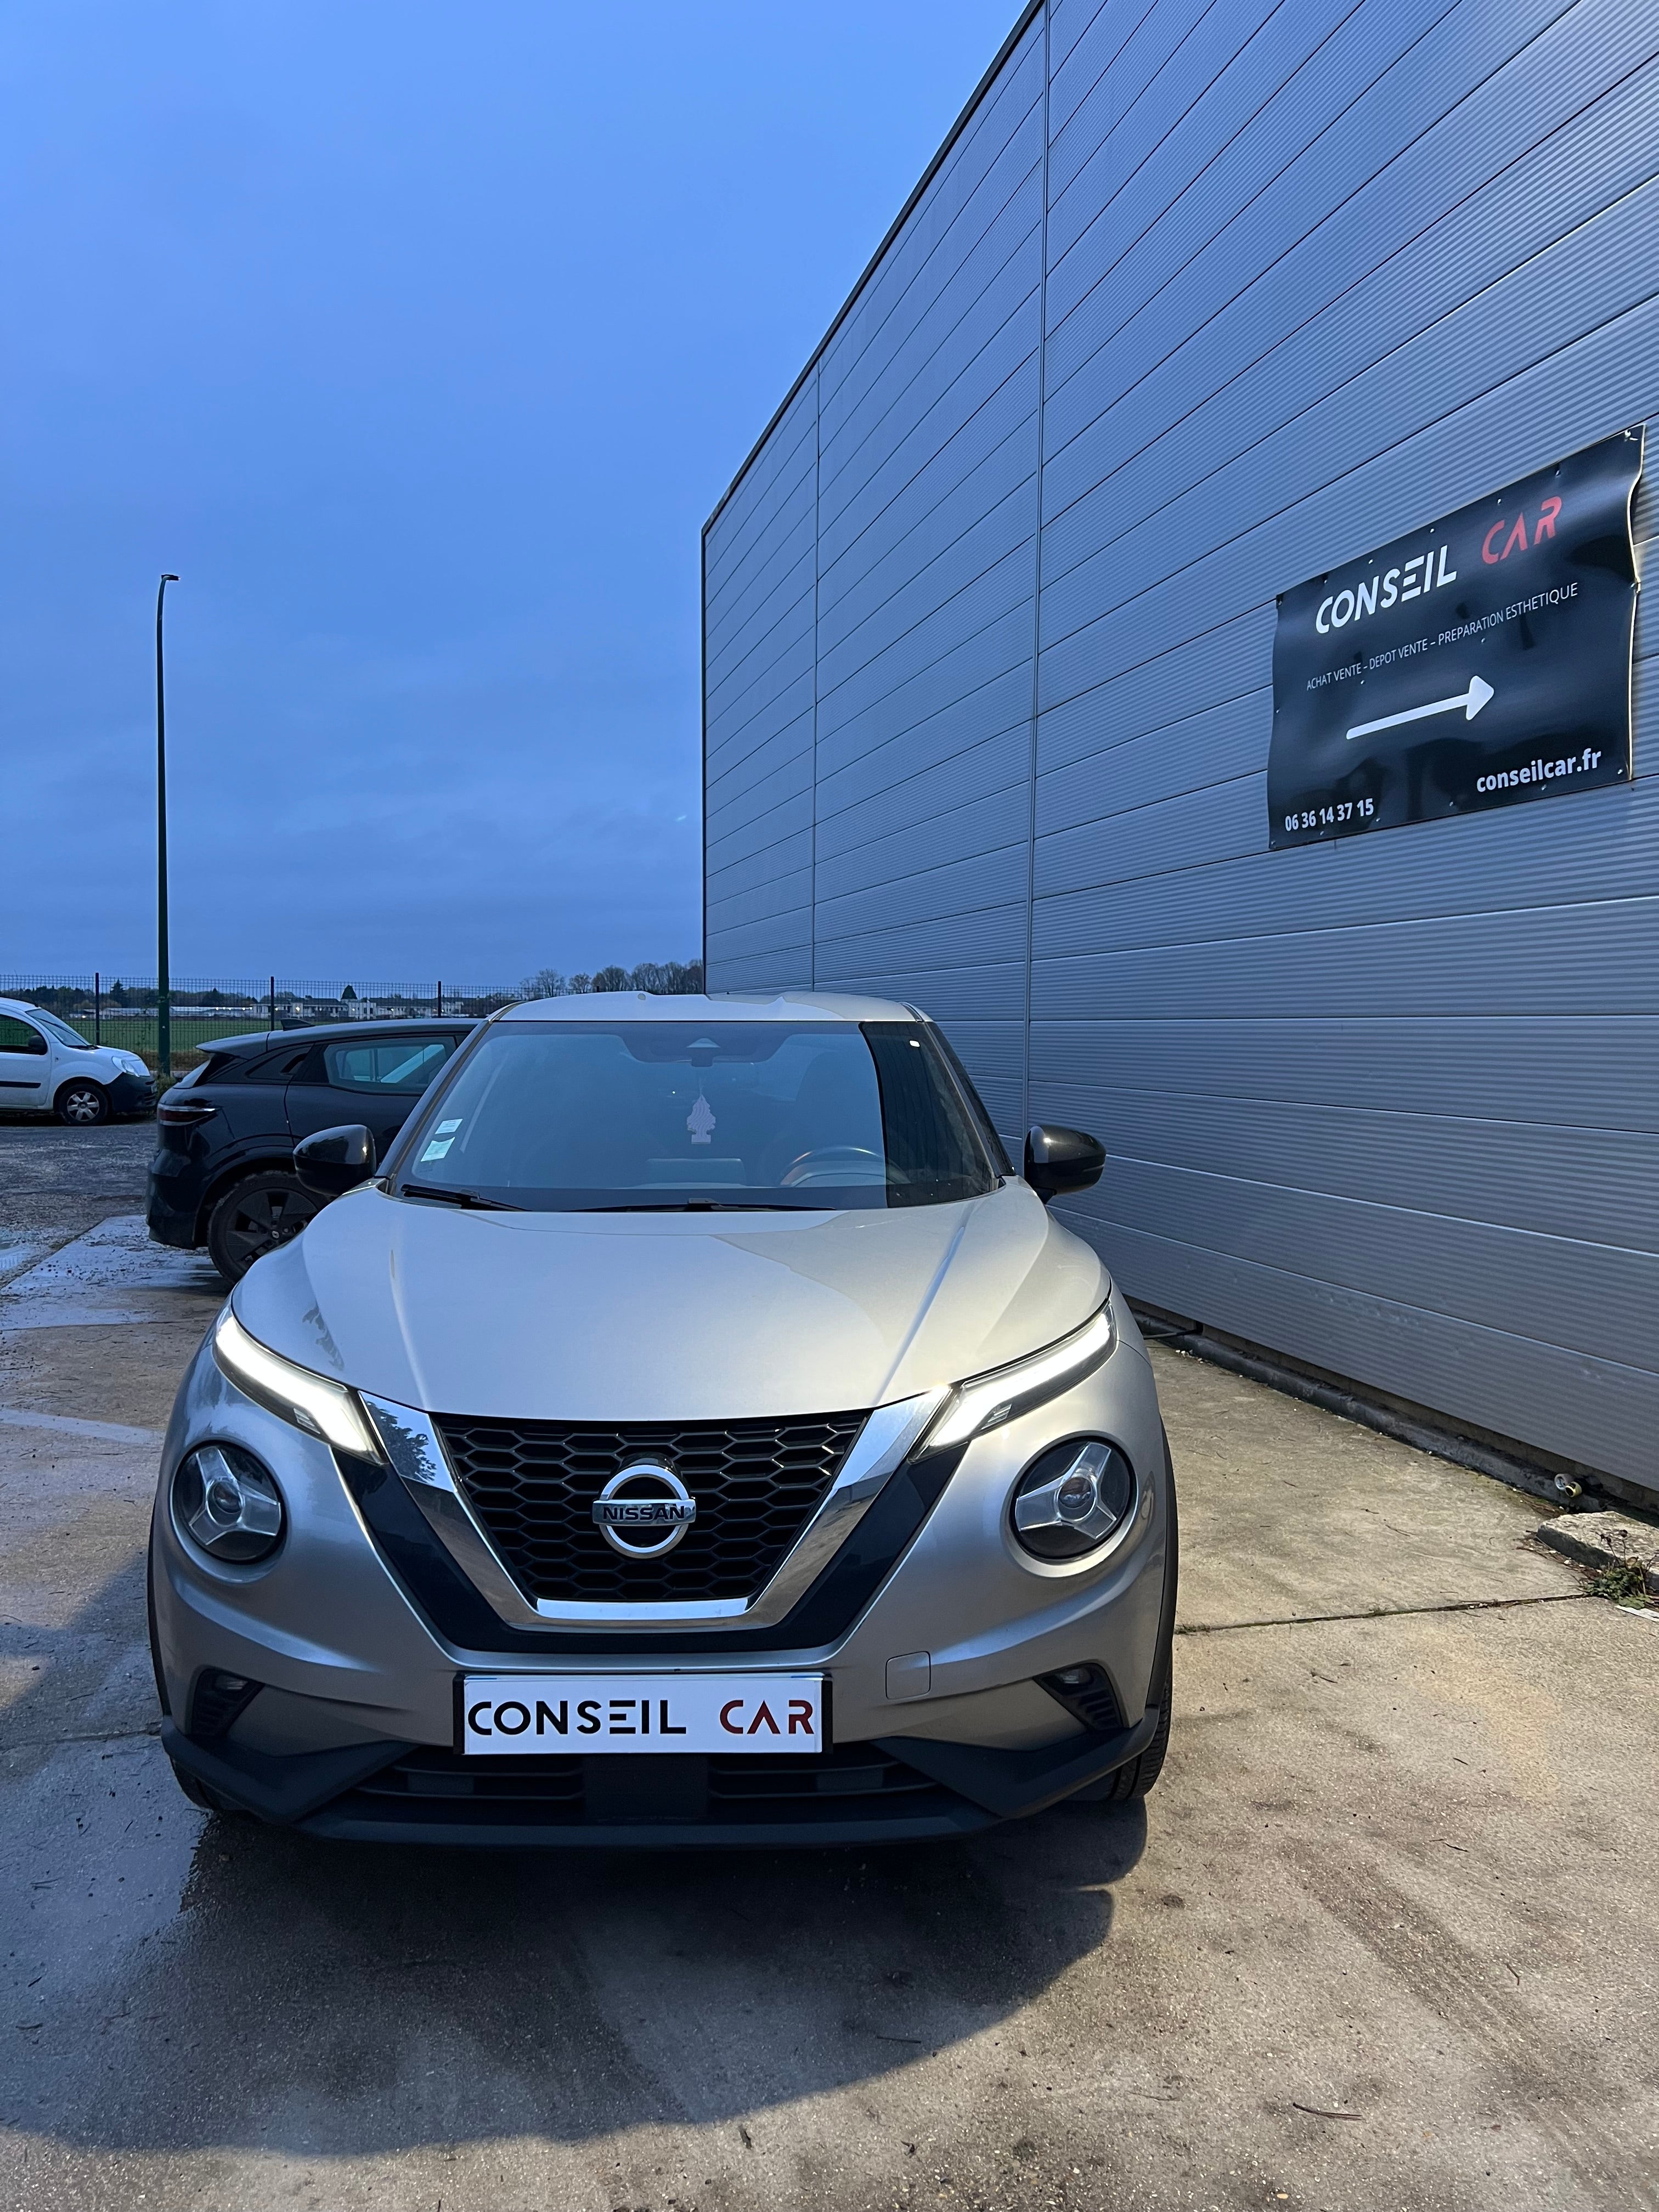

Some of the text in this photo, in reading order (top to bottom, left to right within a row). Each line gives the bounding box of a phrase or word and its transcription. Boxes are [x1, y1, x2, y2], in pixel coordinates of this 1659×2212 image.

[1316, 496, 1562, 634] CONSEIL CAR
[1306, 672, 1332, 691] ACHAT
[1333, 663, 1362, 681] VENTE
[1369, 650, 1397, 669] DEPOT
[1398, 638, 1428, 658] VENTE
[1438, 610, 1504, 646] PREPARATION
[1506, 582, 1578, 620] ESTHETIQUE
[1476, 748, 1601, 792] conseilcar.fr
[1285, 798, 1374, 831] 06 36 14 37 15
[603, 1505, 685, 1520] NISSAN
[467, 1700, 814, 1735] CONSEIL CAR
